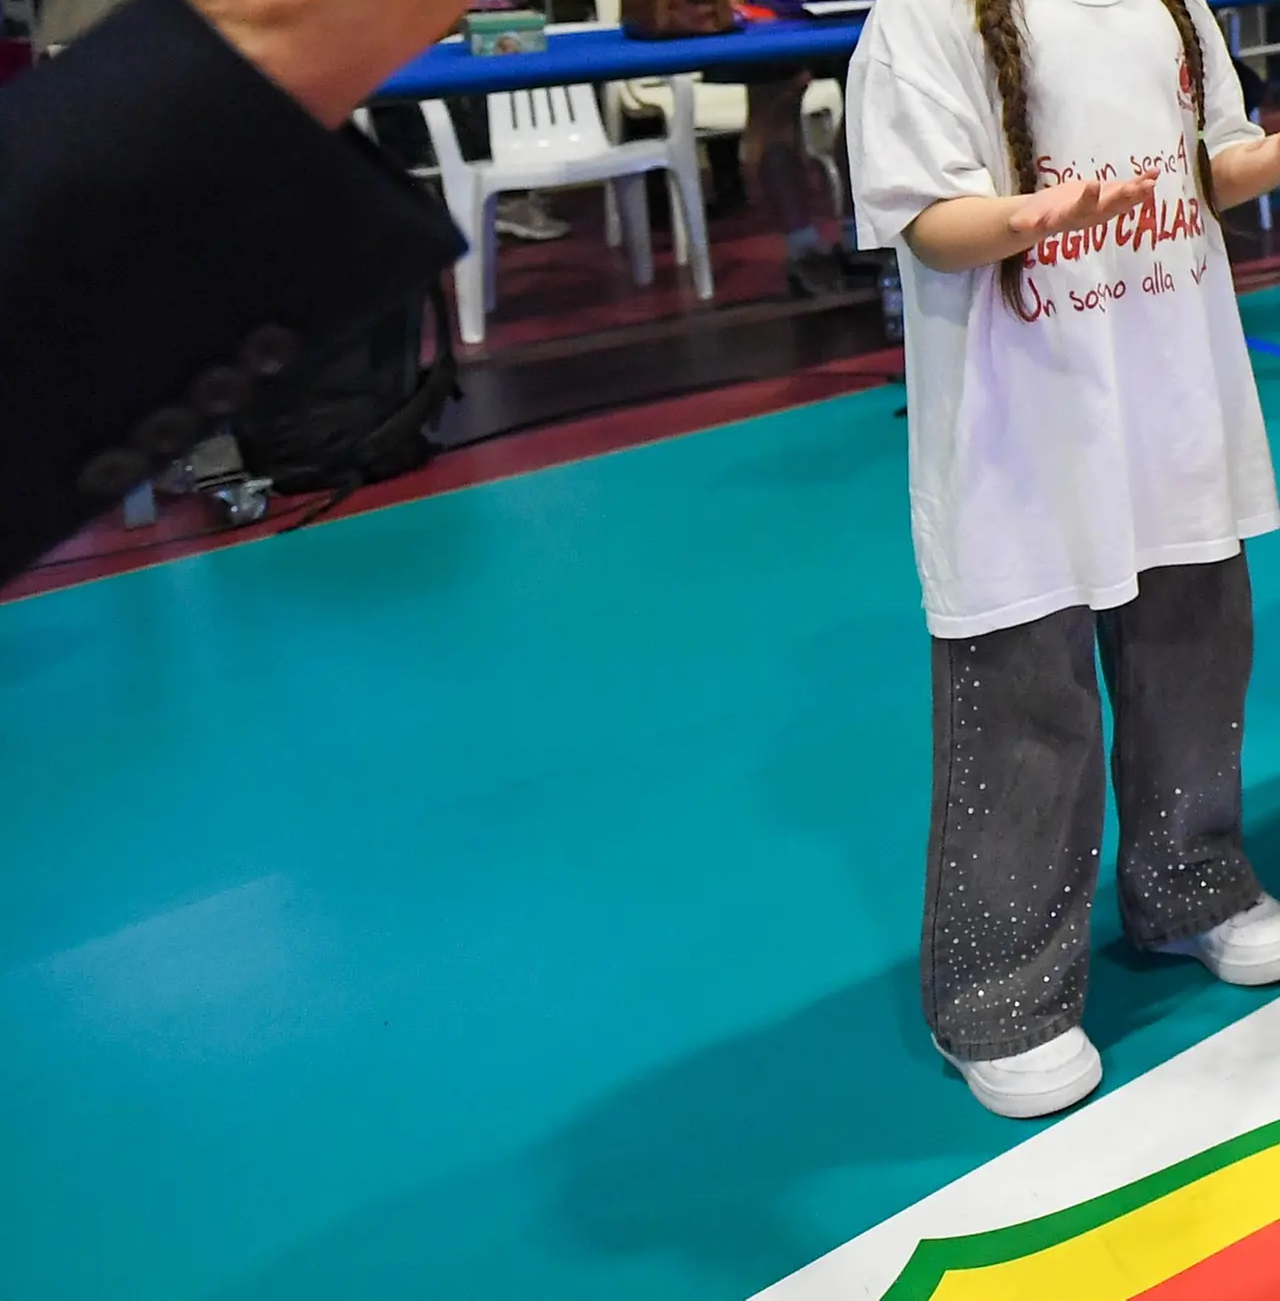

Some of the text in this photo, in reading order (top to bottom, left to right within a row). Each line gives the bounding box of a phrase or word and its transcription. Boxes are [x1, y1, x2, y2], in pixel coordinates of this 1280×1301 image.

[1036, 156, 1082, 188] Sei
[1091, 157, 1117, 181] in
[1018, 277, 1057, 323] Un
[1142, 261, 1176, 296] alla
